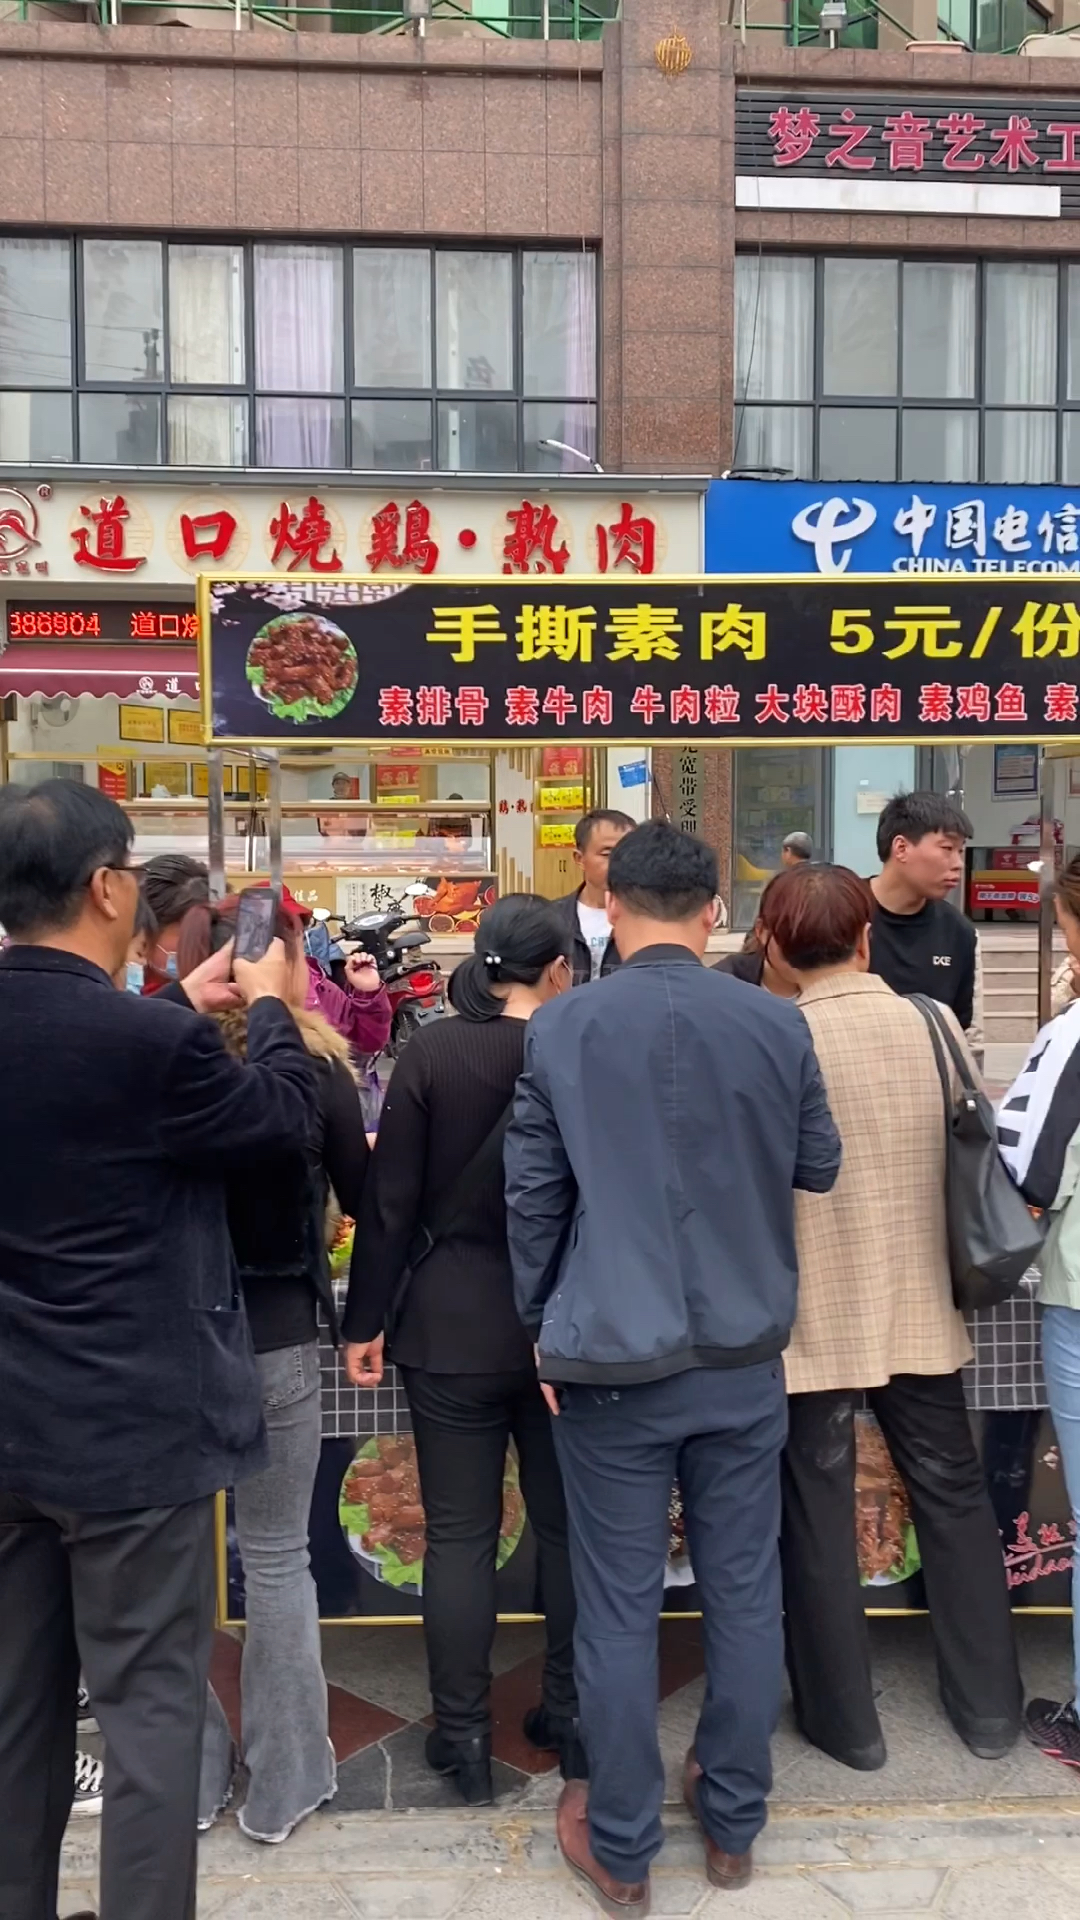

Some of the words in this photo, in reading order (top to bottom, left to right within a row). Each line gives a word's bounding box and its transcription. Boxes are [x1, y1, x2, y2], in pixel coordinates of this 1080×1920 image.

[767, 106, 1080, 173] 梦之音艺术工
[893, 494, 1080, 557] 中国电信
[892, 557, 967, 573] CHINA
[972, 559, 1080, 573] TELECOM
[426, 602, 768, 662] 手撕素肉
[830, 601, 1080, 660] 5元/份
[378, 685, 489, 725] 素排骨
[505, 685, 613, 725] 素牛肉
[630, 684, 741, 724] 牛肉粒
[755, 683, 902, 723] 大块酥肉
[918, 682, 1028, 722] 素鸡鱼
[1043, 682, 1079, 721] 素
